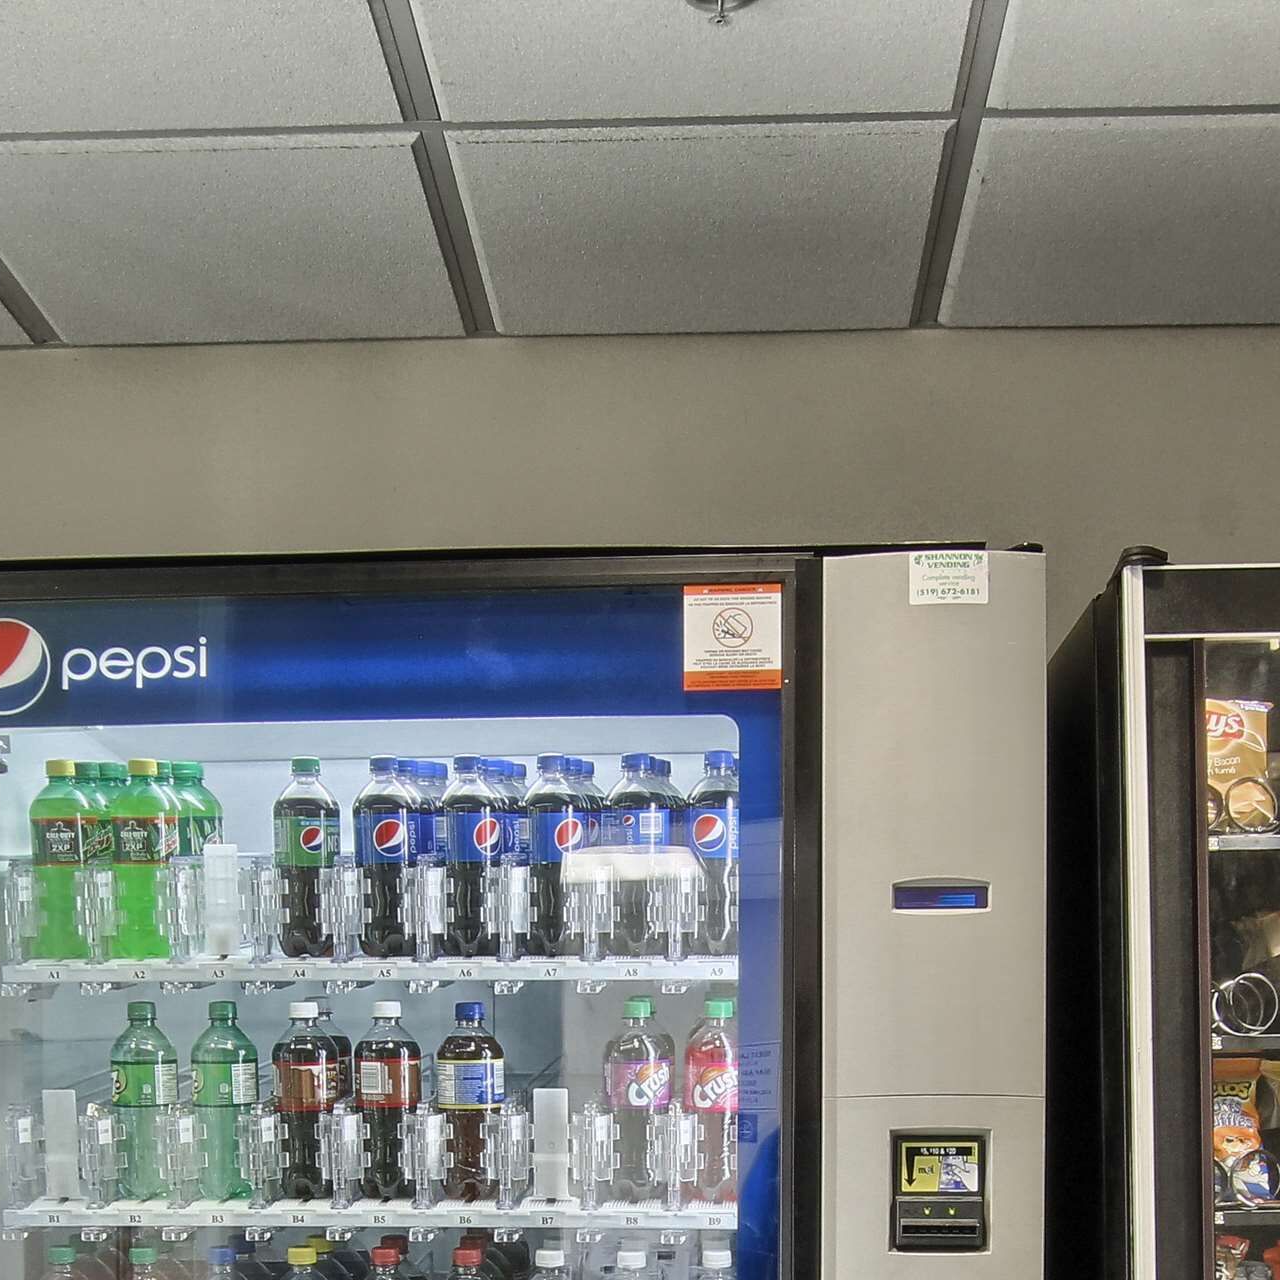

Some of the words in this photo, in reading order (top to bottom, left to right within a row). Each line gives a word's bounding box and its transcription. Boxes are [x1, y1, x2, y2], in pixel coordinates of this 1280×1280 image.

[924, 553, 973, 561] SHANNON
[62, 637, 209, 690] pepsi
[409, 819, 417, 854] pepsi
[48, 971, 60, 979] A1
[133, 970, 145, 979] A2
[212, 970, 225, 978] A3
[293, 969, 306, 978] A4
[379, 969, 391, 978] A5
[458, 969, 472, 977] A6
[543, 968, 557, 977] A7
[623, 968, 638, 977] A8
[709, 967, 724, 977] A9
[627, 1064, 670, 1106] Crush
[48, 1214, 60, 1223] B1
[129, 1214, 141, 1223] B2
[212, 1215, 224, 1224] B3
[292, 1215, 305, 1224] B4
[373, 1215, 386, 1224] B5
[459, 1215, 472, 1225] B6
[541, 1216, 554, 1225] B7
[625, 1216, 639, 1225] B8
[708, 1217, 721, 1226] B9
